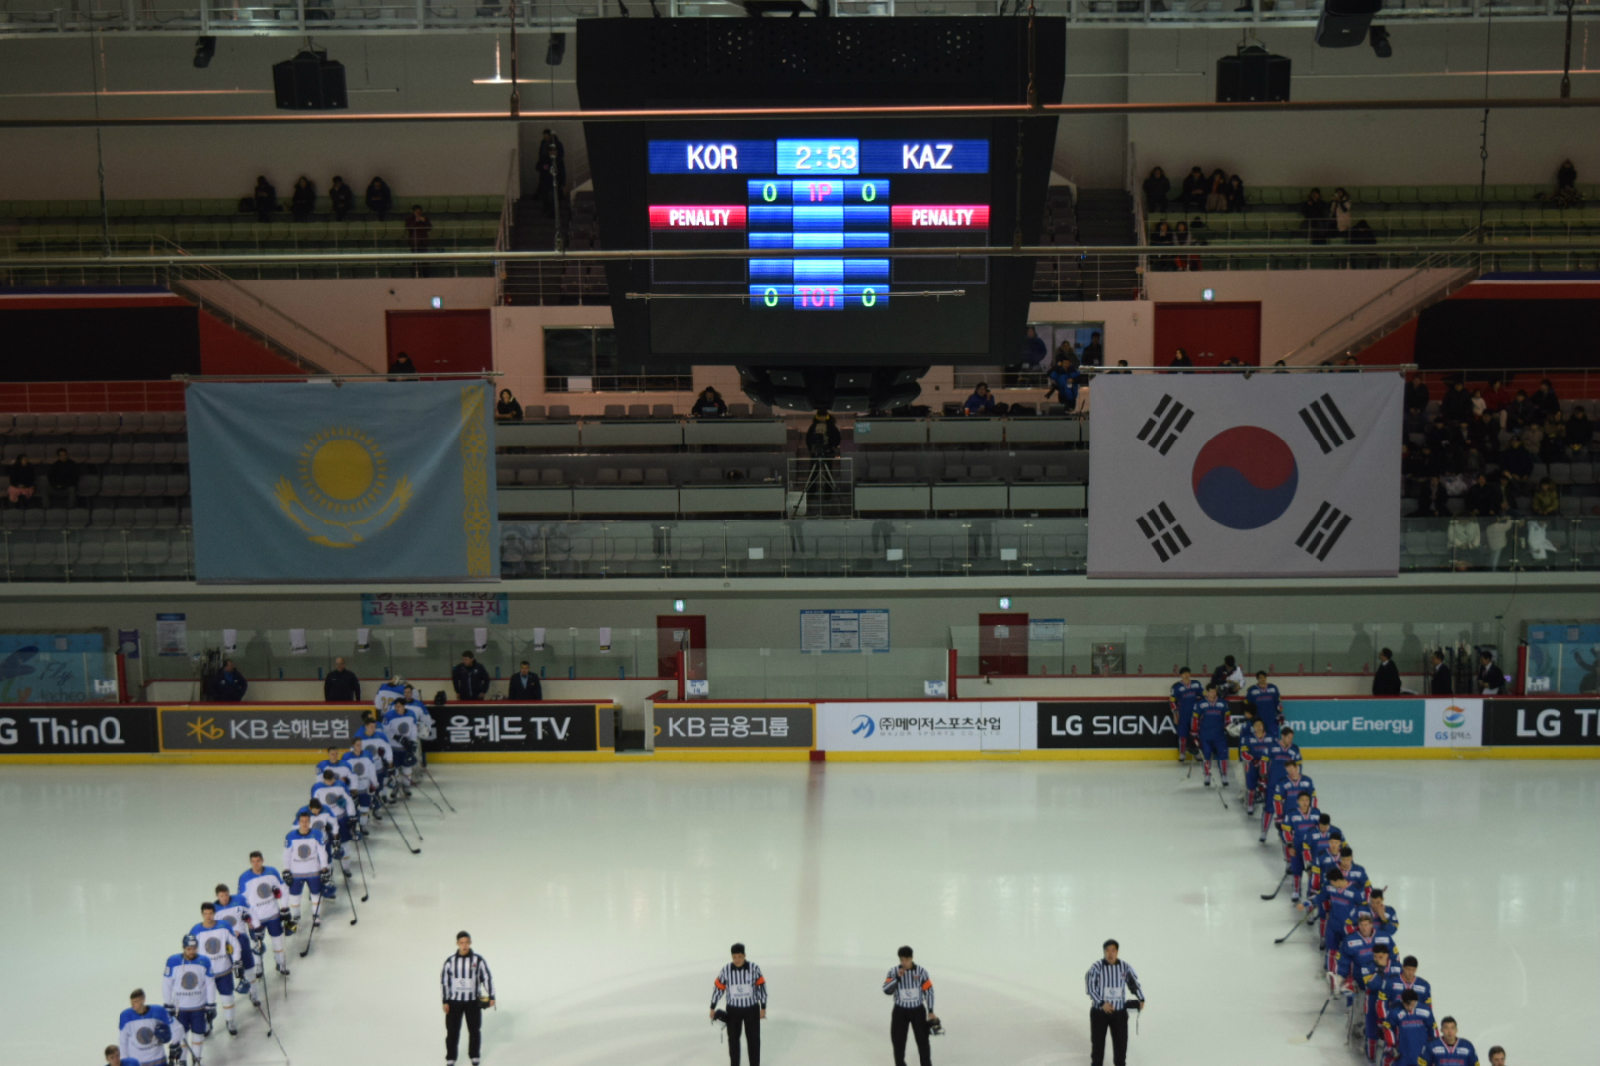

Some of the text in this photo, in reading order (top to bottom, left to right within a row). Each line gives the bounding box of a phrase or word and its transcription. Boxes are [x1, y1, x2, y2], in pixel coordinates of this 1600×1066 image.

[687, 144, 738, 170] KOR
[795, 145, 857, 170] 2:53
[902, 144, 953, 170] KAZ
[763, 183, 777, 202] 0
[808, 182, 833, 202] 1P
[862, 183, 876, 202] 0
[669, 208, 731, 227] PENALTY
[911, 208, 973, 227] PENALTY
[764, 287, 778, 308] 0
[798, 286, 839, 307] TOT
[862, 287, 876, 308] 0
[440, 599, 501, 617] 점프금지
[29, 716, 126, 745] ThinQ
[230, 718, 350, 740] KB 손해보험
[447, 714, 527, 743] 올레드
[529, 716, 571, 740] TV
[668, 716, 790, 738] KB 금융그룹
[1051, 715, 1083, 736] LG
[1309, 720, 1349, 734] your
[1352, 716, 1414, 734] Energy
[1516, 709, 1600, 737] LG T
[1434, 731, 1449, 740] GS
